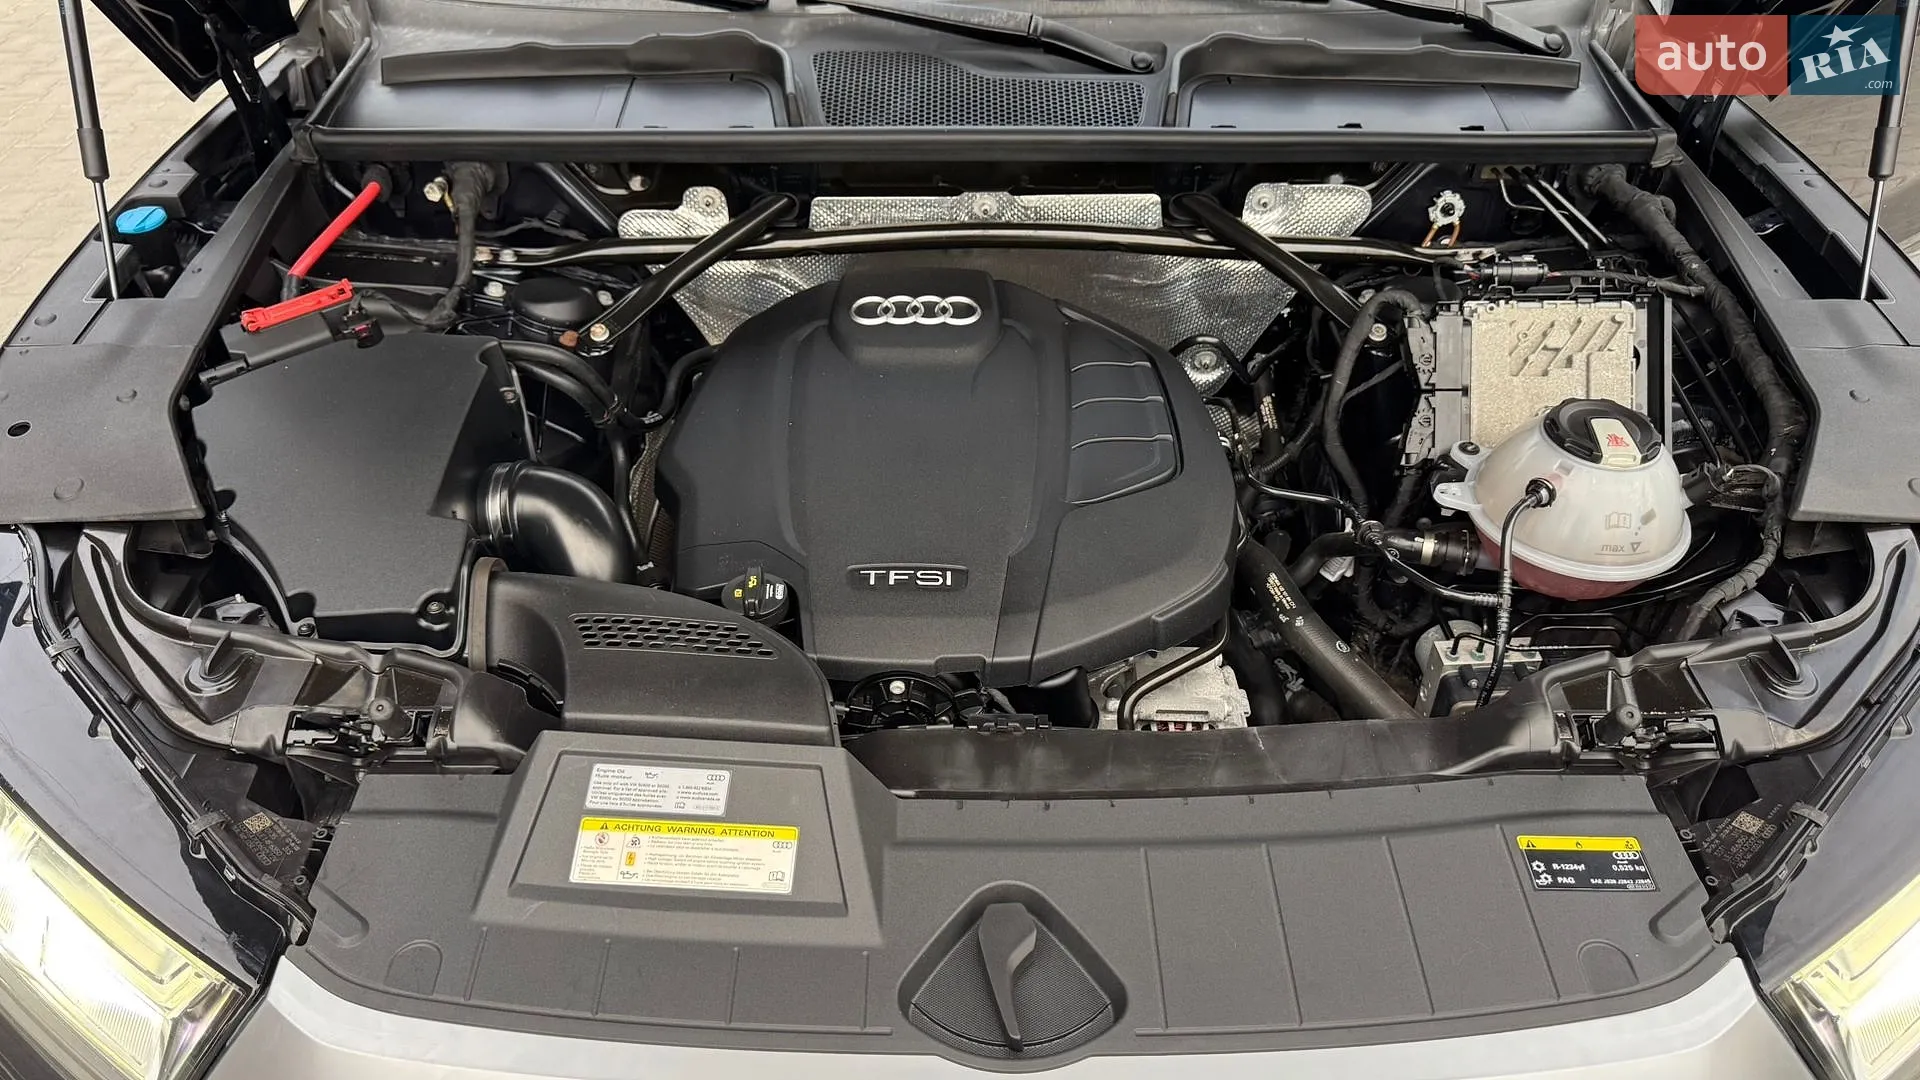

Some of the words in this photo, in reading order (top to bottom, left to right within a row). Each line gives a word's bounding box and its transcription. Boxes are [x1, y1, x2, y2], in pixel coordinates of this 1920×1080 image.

[1601, 544, 1625, 552] max
[859, 570, 952, 586] TFSI
[613, 823, 662, 833] ACHTUNG
[667, 826, 715, 835] WARNING
[720, 828, 775, 837] ATTENTION
[1635, 864, 1645, 872] kg
